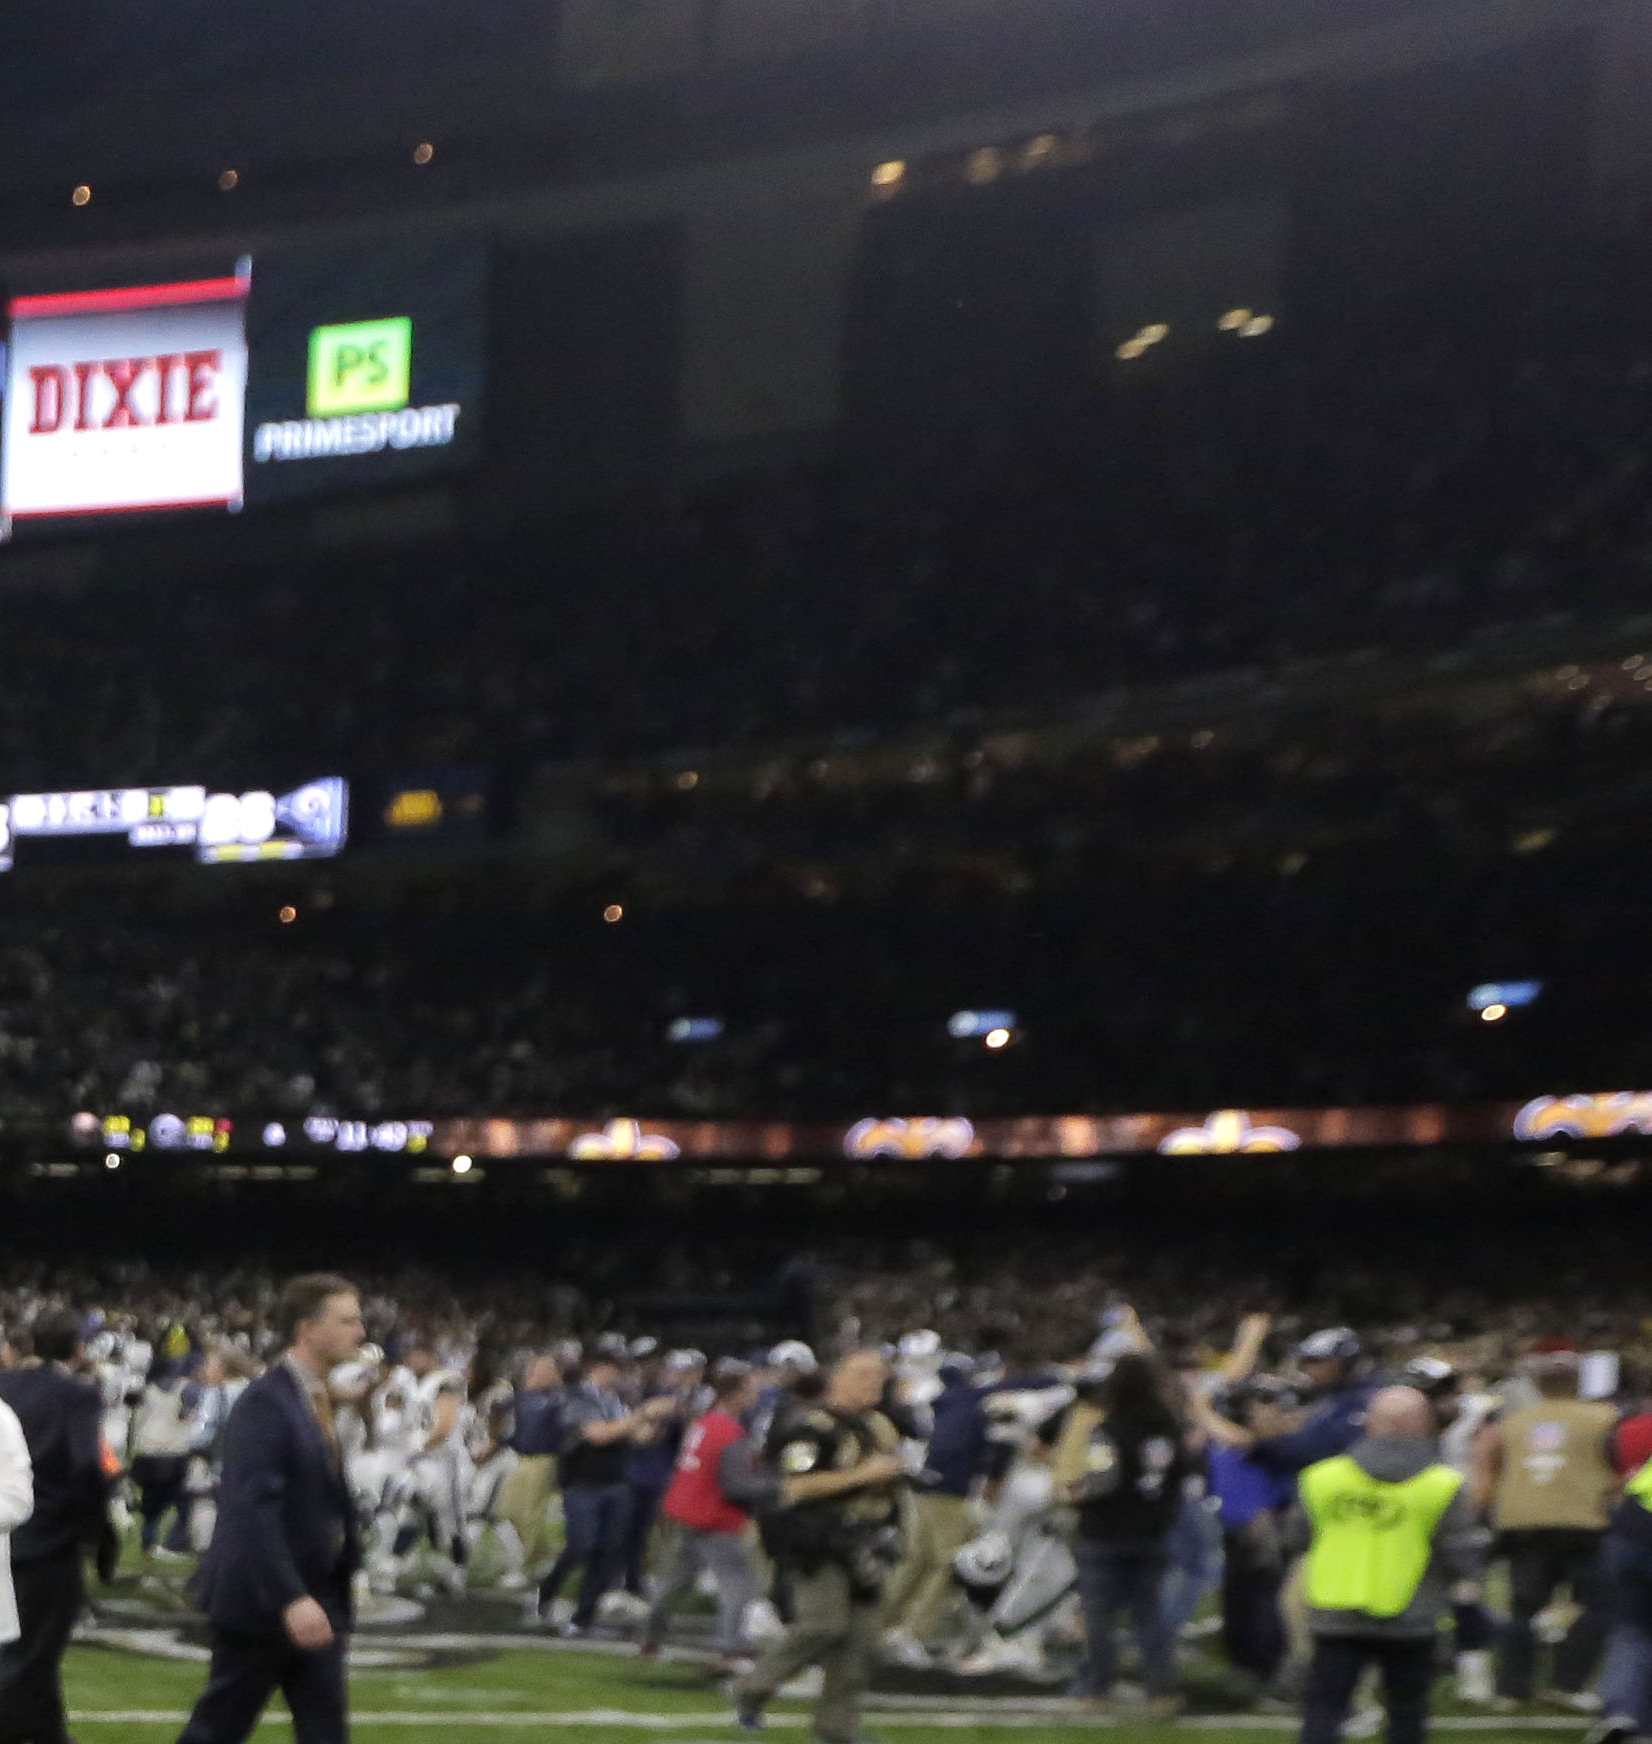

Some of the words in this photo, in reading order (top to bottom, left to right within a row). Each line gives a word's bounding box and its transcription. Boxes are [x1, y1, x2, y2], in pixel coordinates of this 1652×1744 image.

[28, 349, 224, 435] DIXIE
[335, 339, 390, 387] PS
[253, 402, 461, 464] PRIMESPORT
